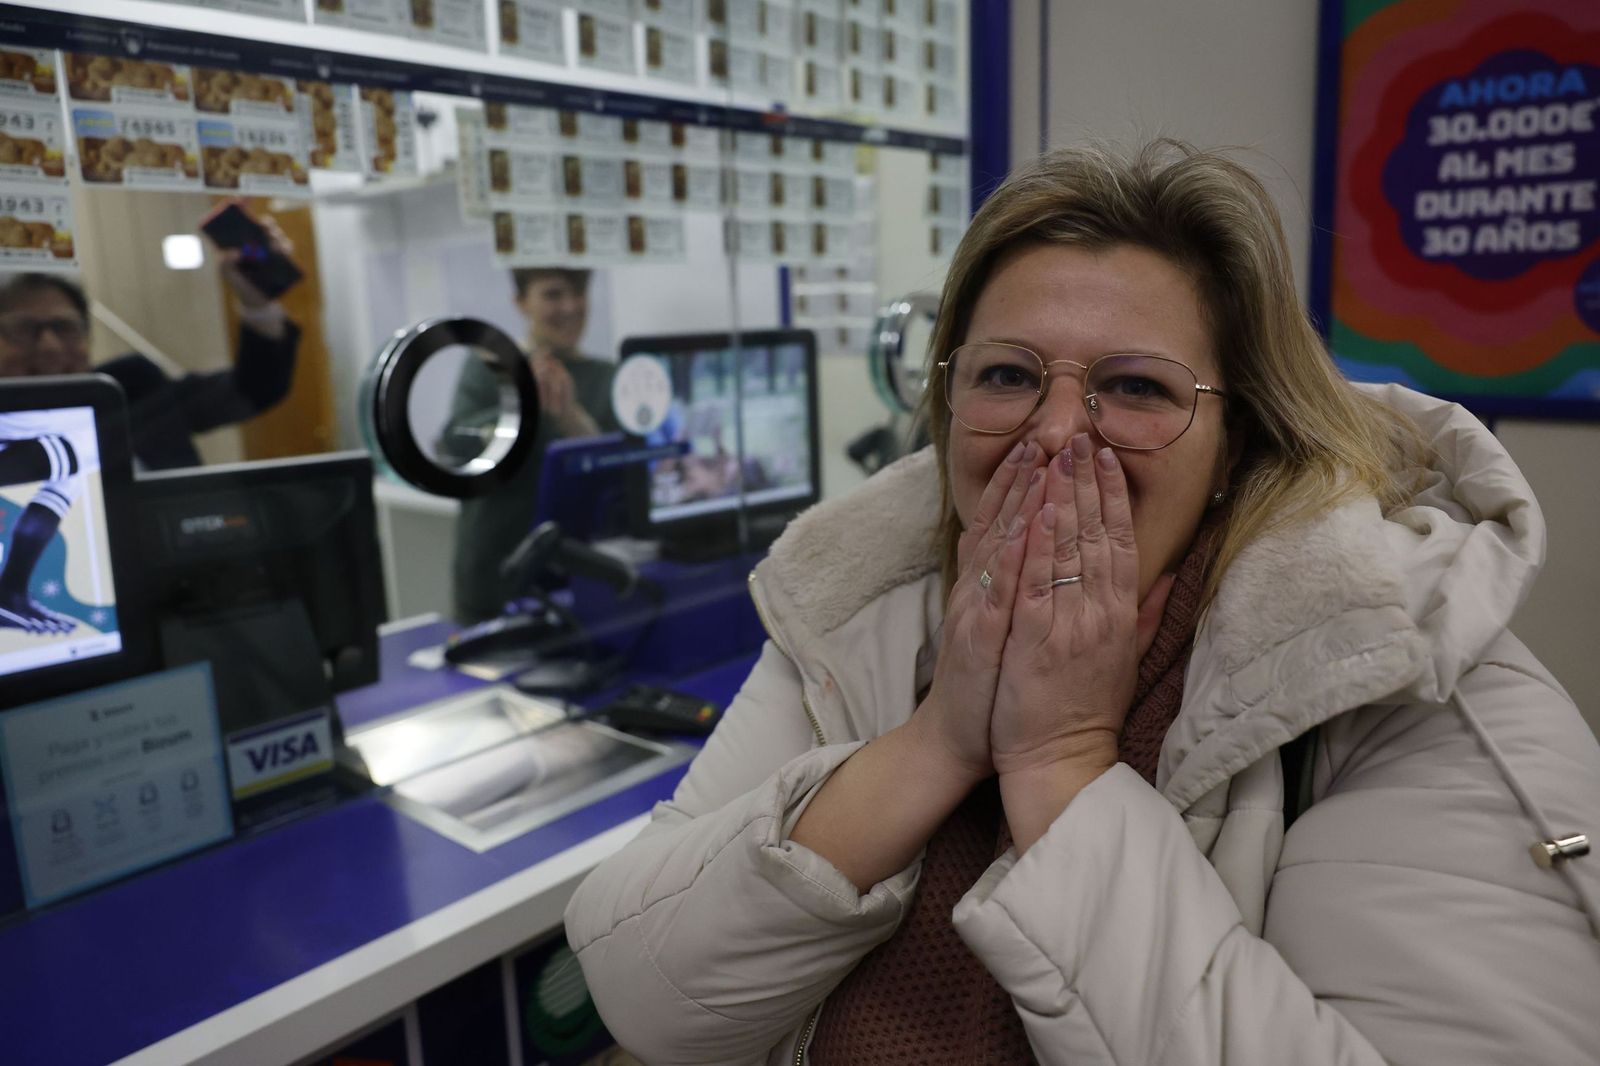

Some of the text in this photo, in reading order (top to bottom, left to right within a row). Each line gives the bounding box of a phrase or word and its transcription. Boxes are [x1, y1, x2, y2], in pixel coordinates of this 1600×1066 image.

[1440, 69, 1585, 107] AHORA
[1439, 144, 1574, 181] AL MES
[1416, 182, 1595, 219] DURANTE
[1423, 216, 1580, 255] 30 AÑOS
[245, 732, 318, 772] VISA
